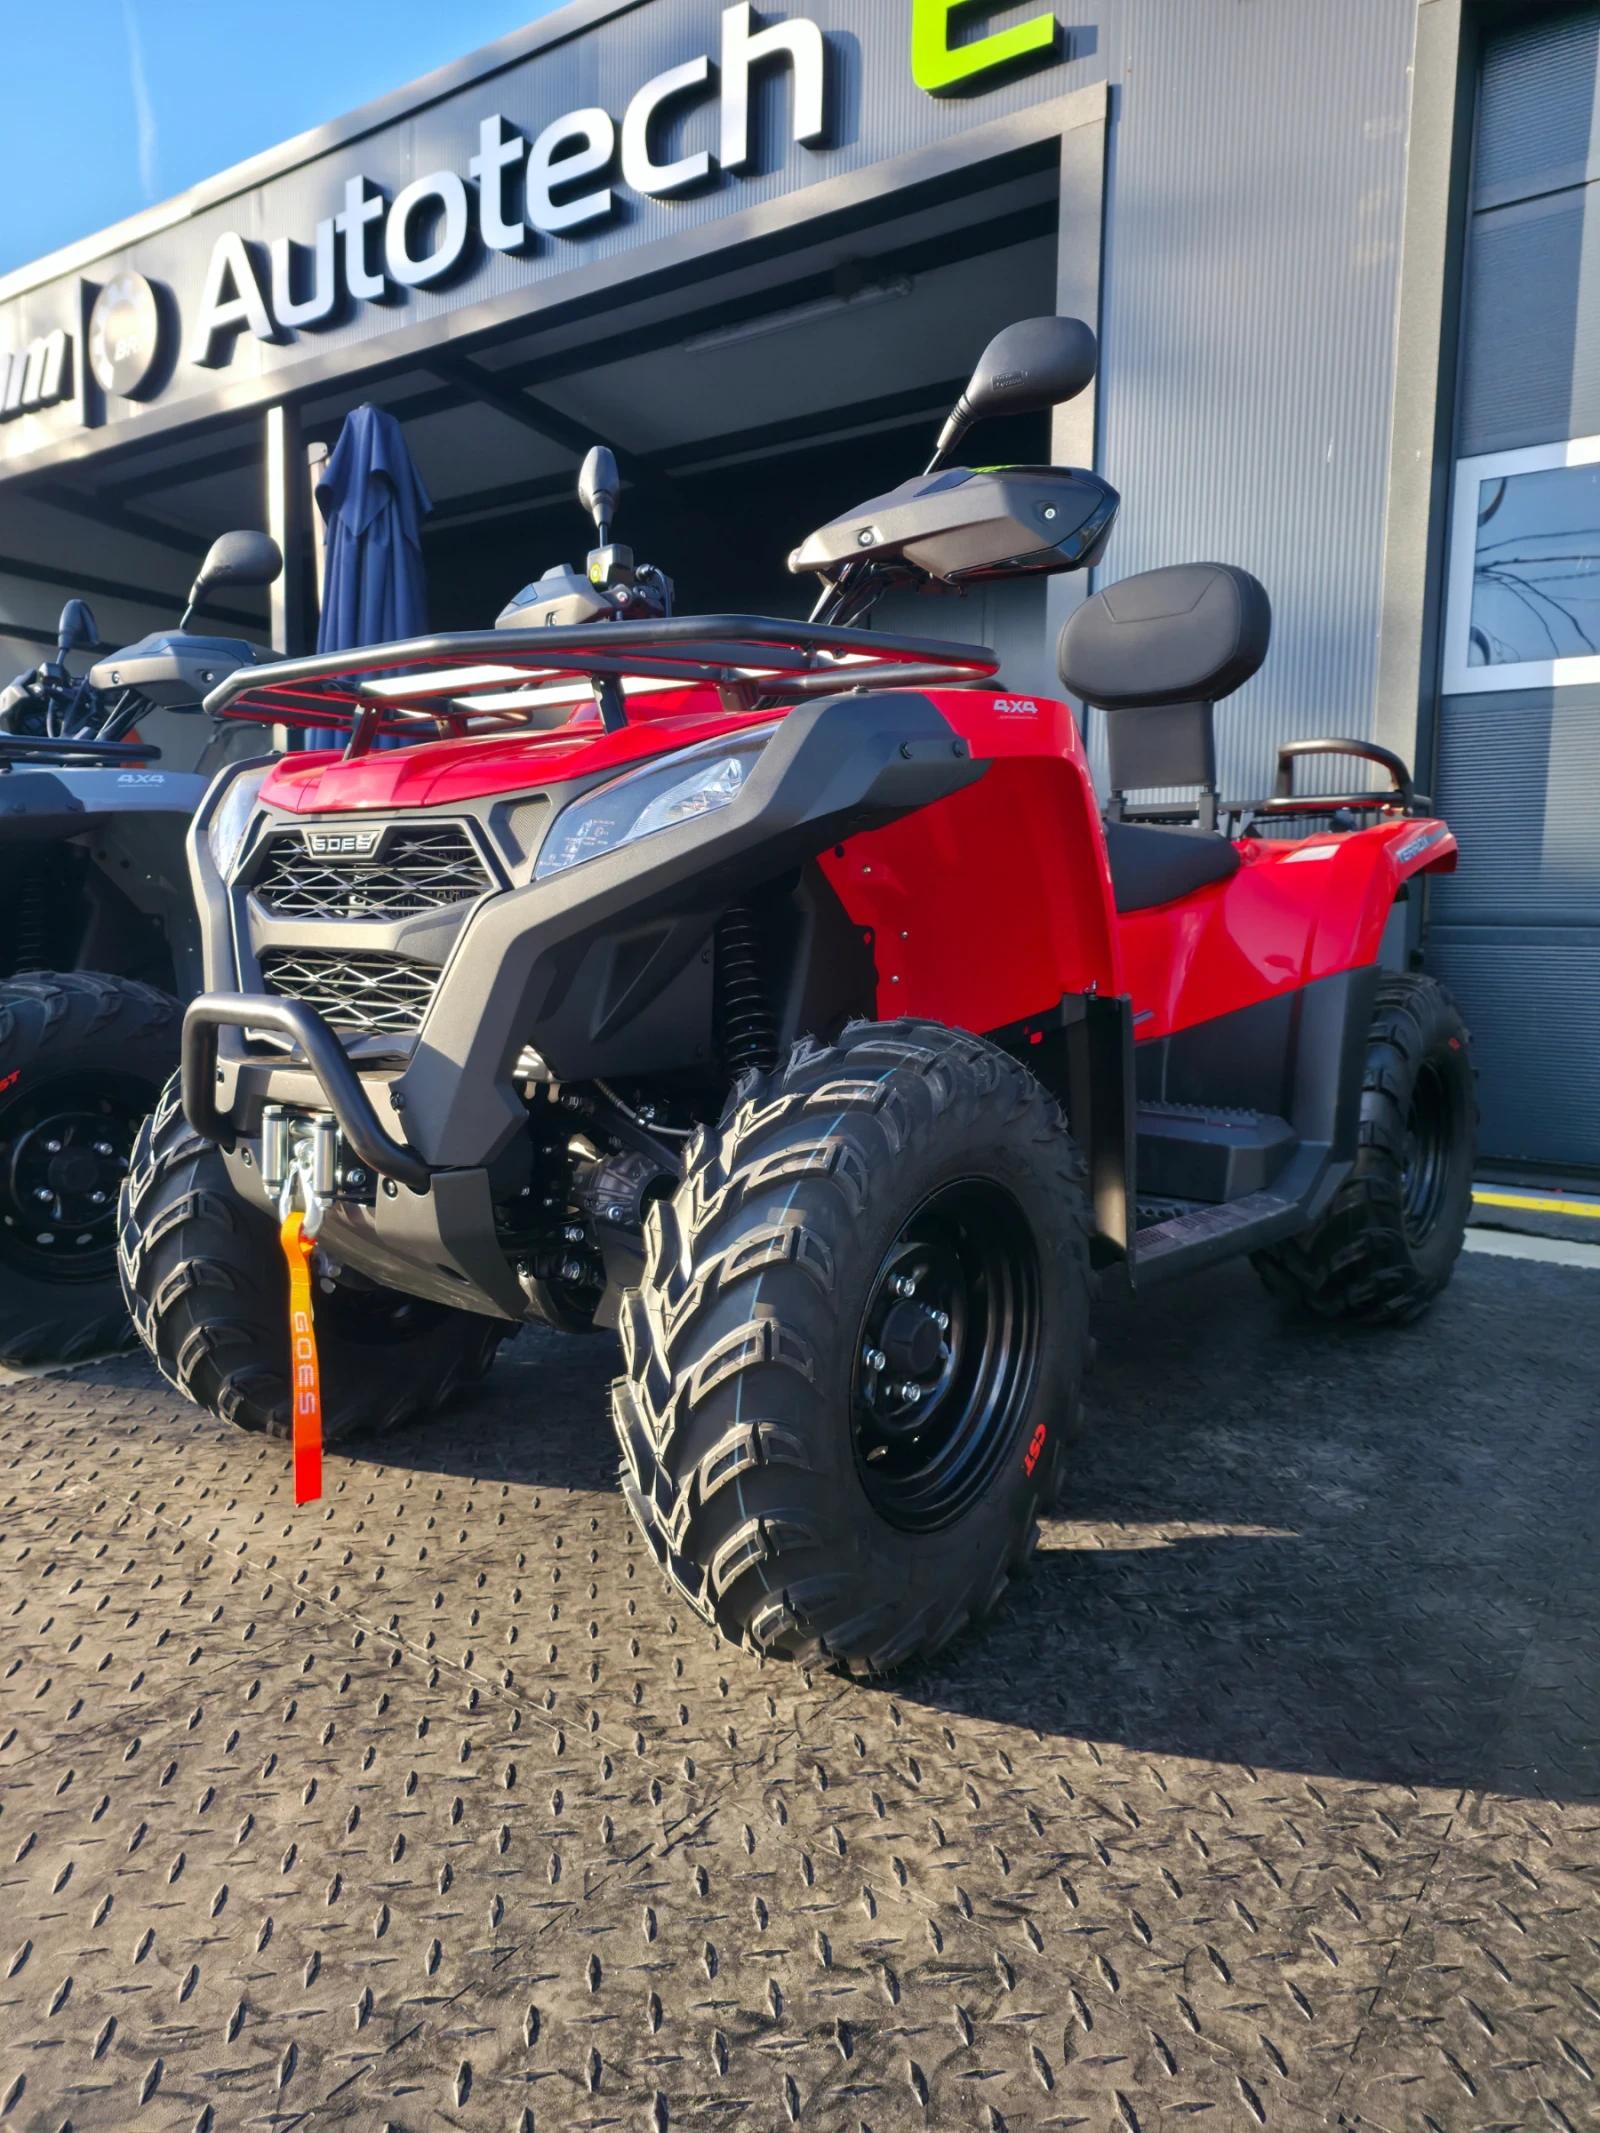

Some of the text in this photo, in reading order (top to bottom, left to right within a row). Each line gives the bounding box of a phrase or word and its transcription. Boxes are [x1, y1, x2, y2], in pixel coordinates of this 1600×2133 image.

[190, 0, 824, 366] Autotech
[311, 835, 377, 852] GOES
[294, 1311, 316, 1415] GOES
[1024, 1423, 1047, 1477] CST
